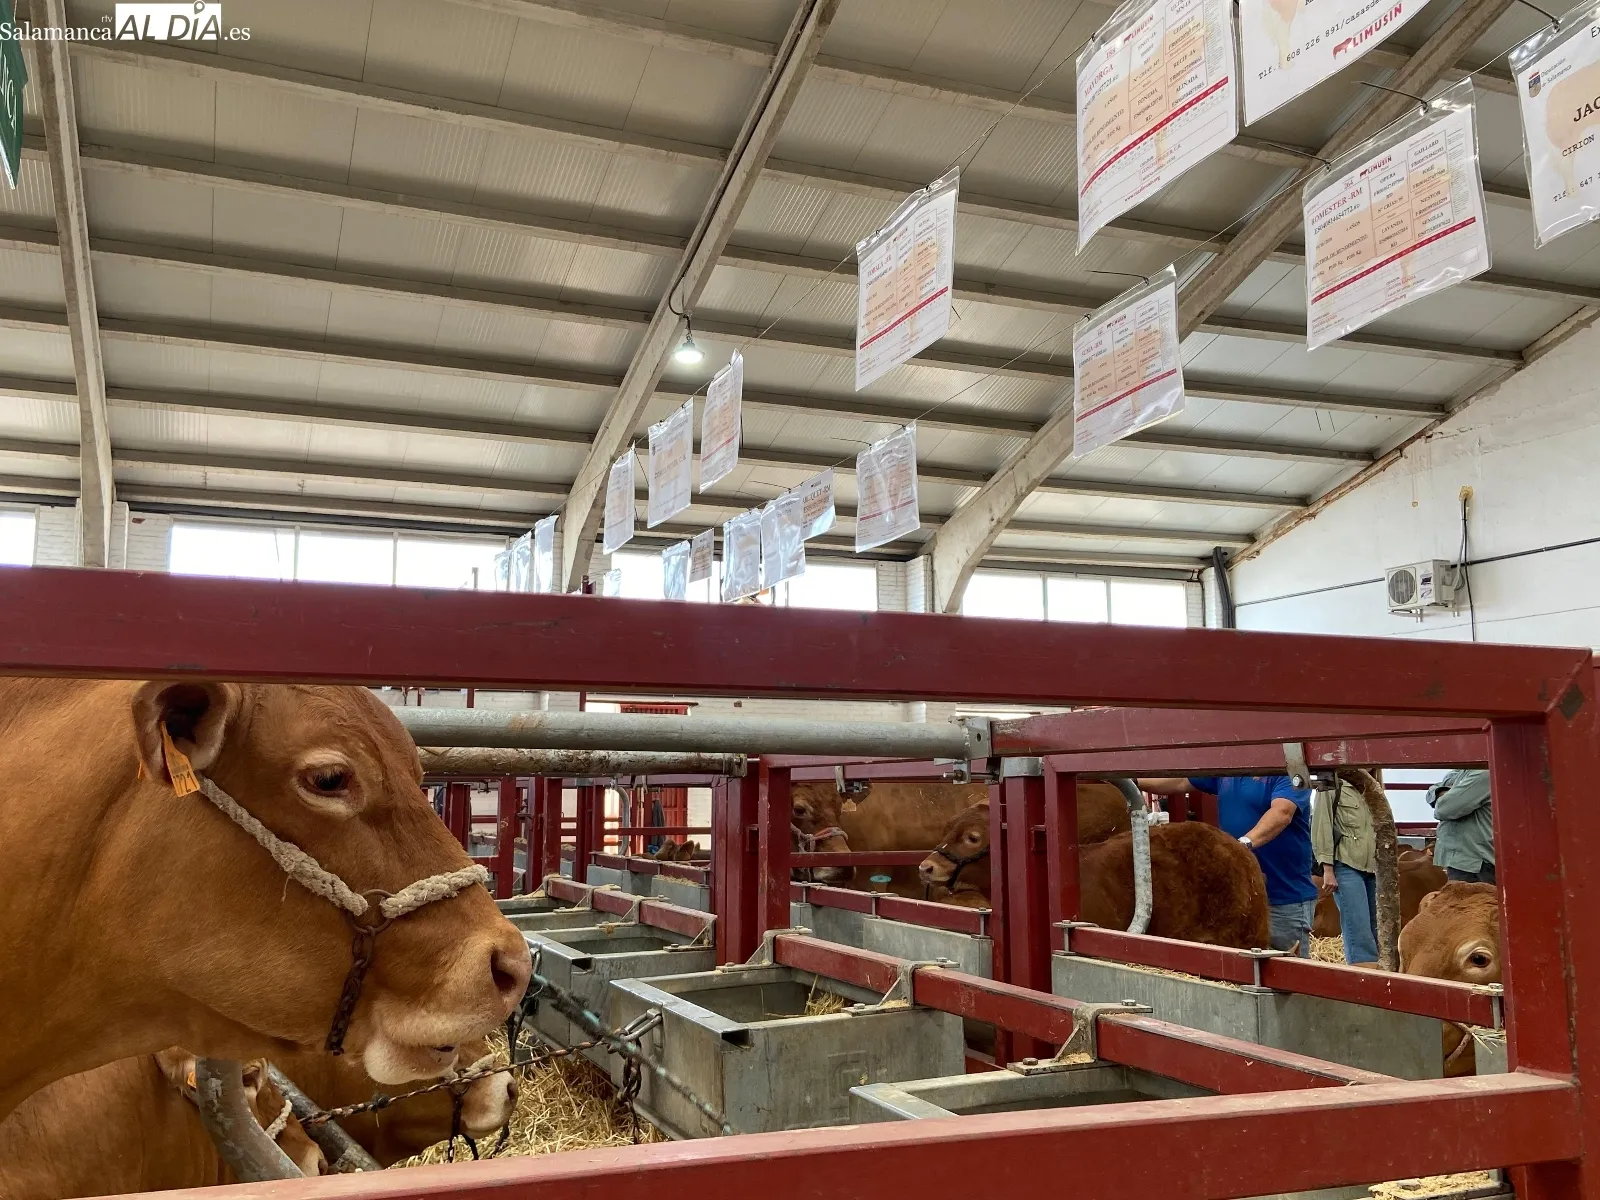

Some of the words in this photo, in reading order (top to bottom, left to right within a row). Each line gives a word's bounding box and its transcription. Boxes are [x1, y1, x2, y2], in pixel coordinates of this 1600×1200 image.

[1352, 3, 1403, 47] LIMUSIN
[1286, 48, 1301, 62] 608
[1305, 36, 1321, 51] 226
[1547, 64, 1572, 84] Salamanca
[1562, 134, 1595, 157] CIRION
